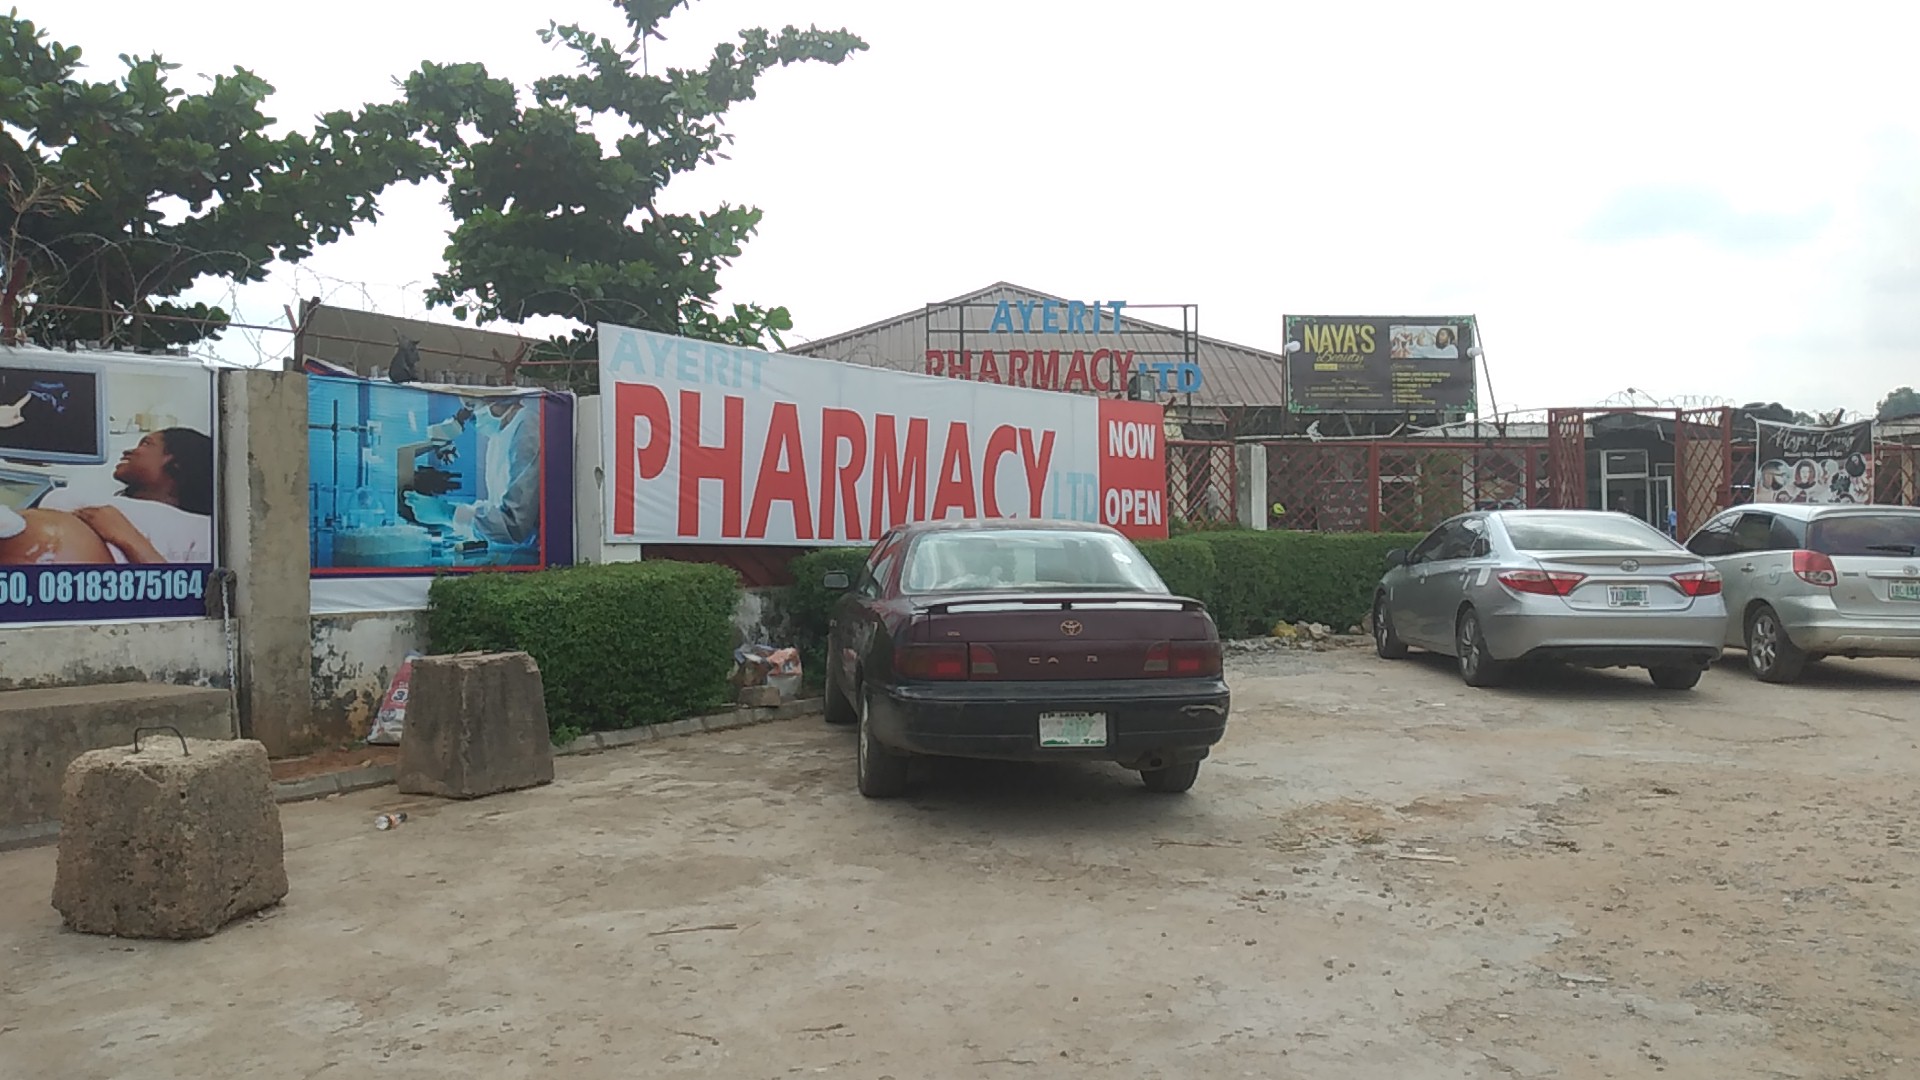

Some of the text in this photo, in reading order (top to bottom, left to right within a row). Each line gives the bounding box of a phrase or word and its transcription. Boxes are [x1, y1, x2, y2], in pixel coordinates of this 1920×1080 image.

[989, 300, 1127, 334] AYERIT
[1304, 323, 1376, 354] NAYA'S
[608, 332, 770, 390] AYERIT
[926, 348, 1135, 392] PHARMACY
[1108, 420, 1156, 460] NOW
[613, 381, 1057, 541] PHARMACY
[1052, 472, 1097, 524] LTD
[1105, 488, 1162, 527] OPEN
[39, 570, 203, 603] 08183875164
